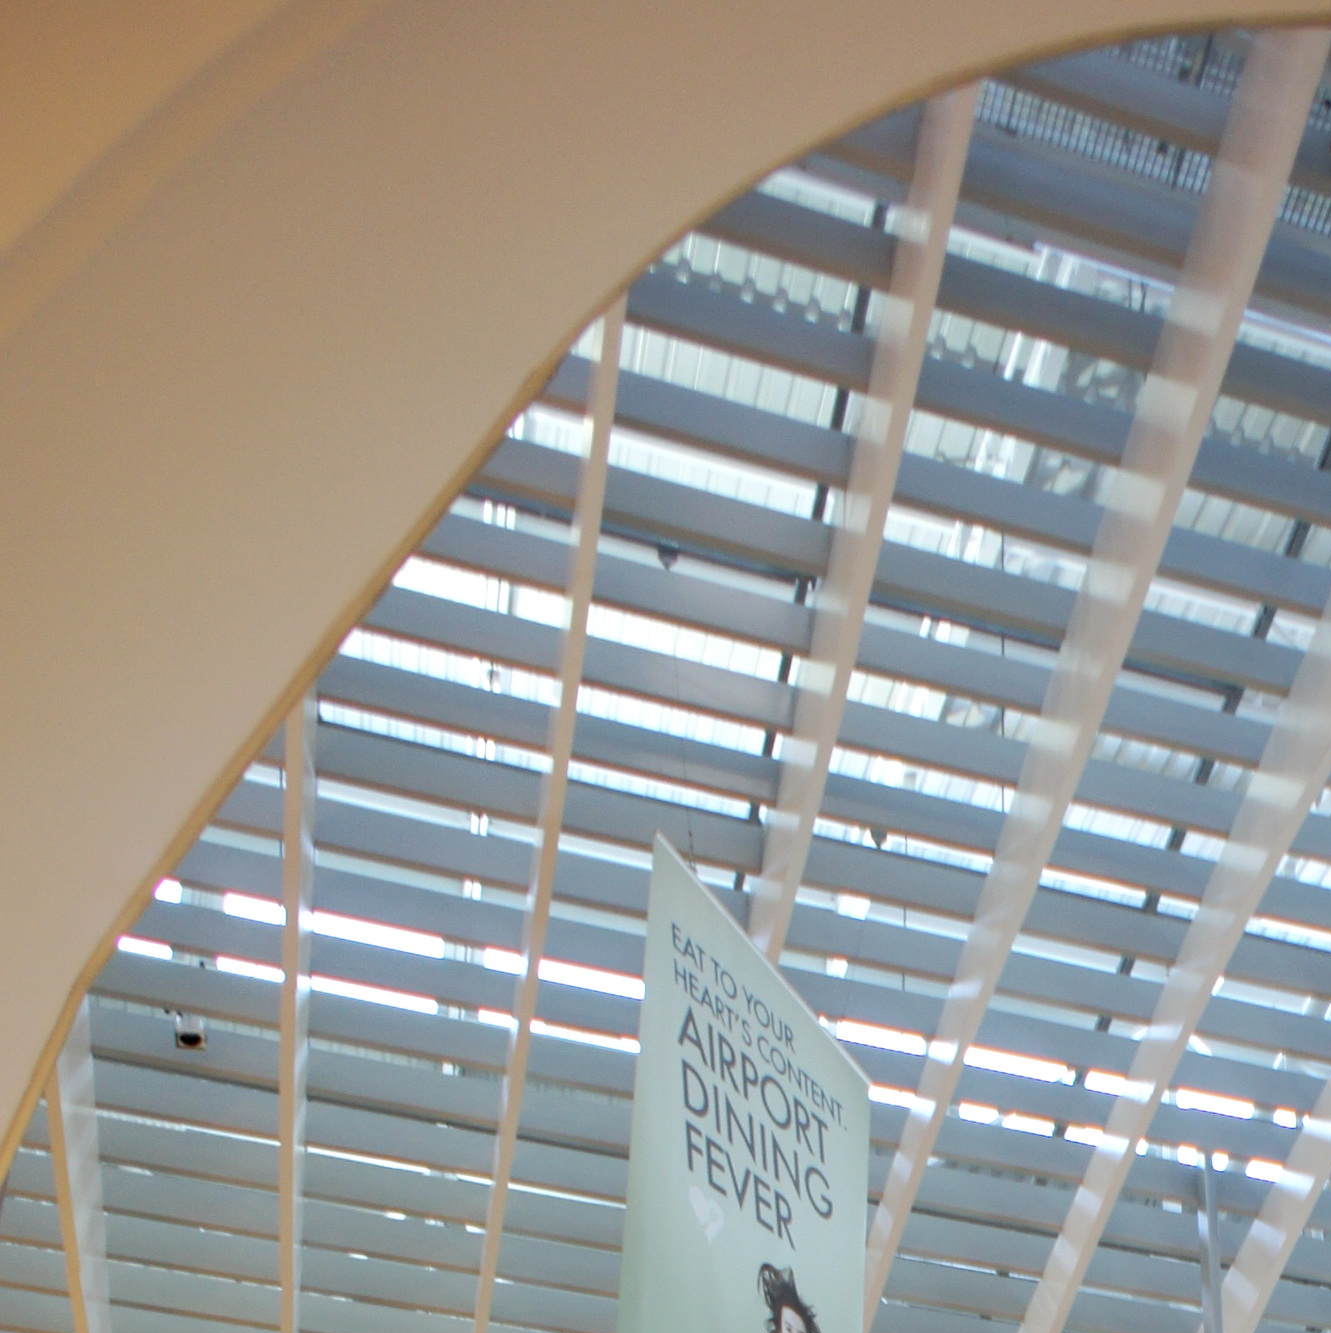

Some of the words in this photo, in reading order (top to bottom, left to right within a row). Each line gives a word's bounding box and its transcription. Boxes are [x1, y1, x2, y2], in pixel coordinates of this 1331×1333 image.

[671, 922, 704, 972] EAT
[713, 957, 737, 999] TO
[743, 984, 796, 1055] YOUR
[673, 959, 752, 1048] HEART'S
[758, 1036, 848, 1133] CONTENT.
[678, 1007, 828, 1164] AIRPORT
[681, 1059, 833, 1220] DINING
[685, 1120, 797, 1251] FEVER
